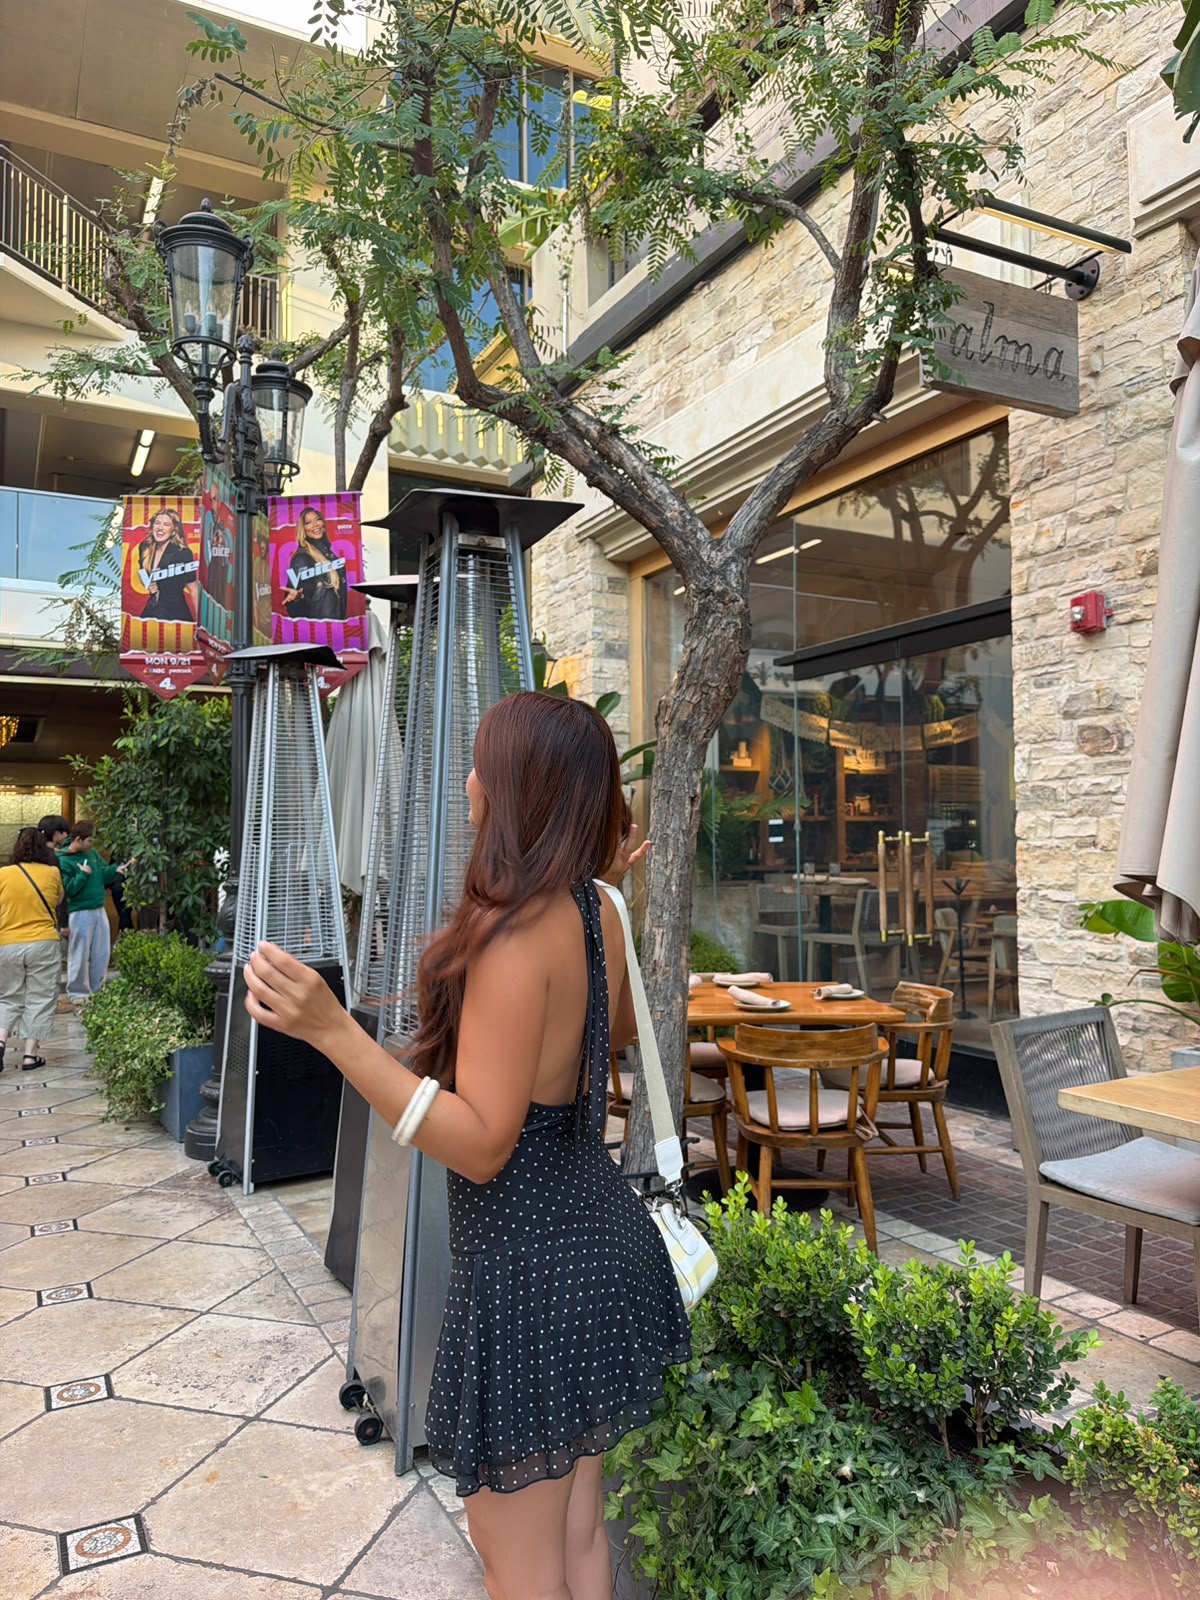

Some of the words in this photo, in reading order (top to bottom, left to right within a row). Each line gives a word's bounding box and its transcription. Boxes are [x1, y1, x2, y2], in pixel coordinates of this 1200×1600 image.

[950, 300, 1066, 382] alma
[138, 560, 200, 590] Voice
[286, 557, 346, 590] Voice
[145, 656, 168, 665] MON
[170, 656, 191, 666] 9/21
[159, 677, 171, 688] 4
